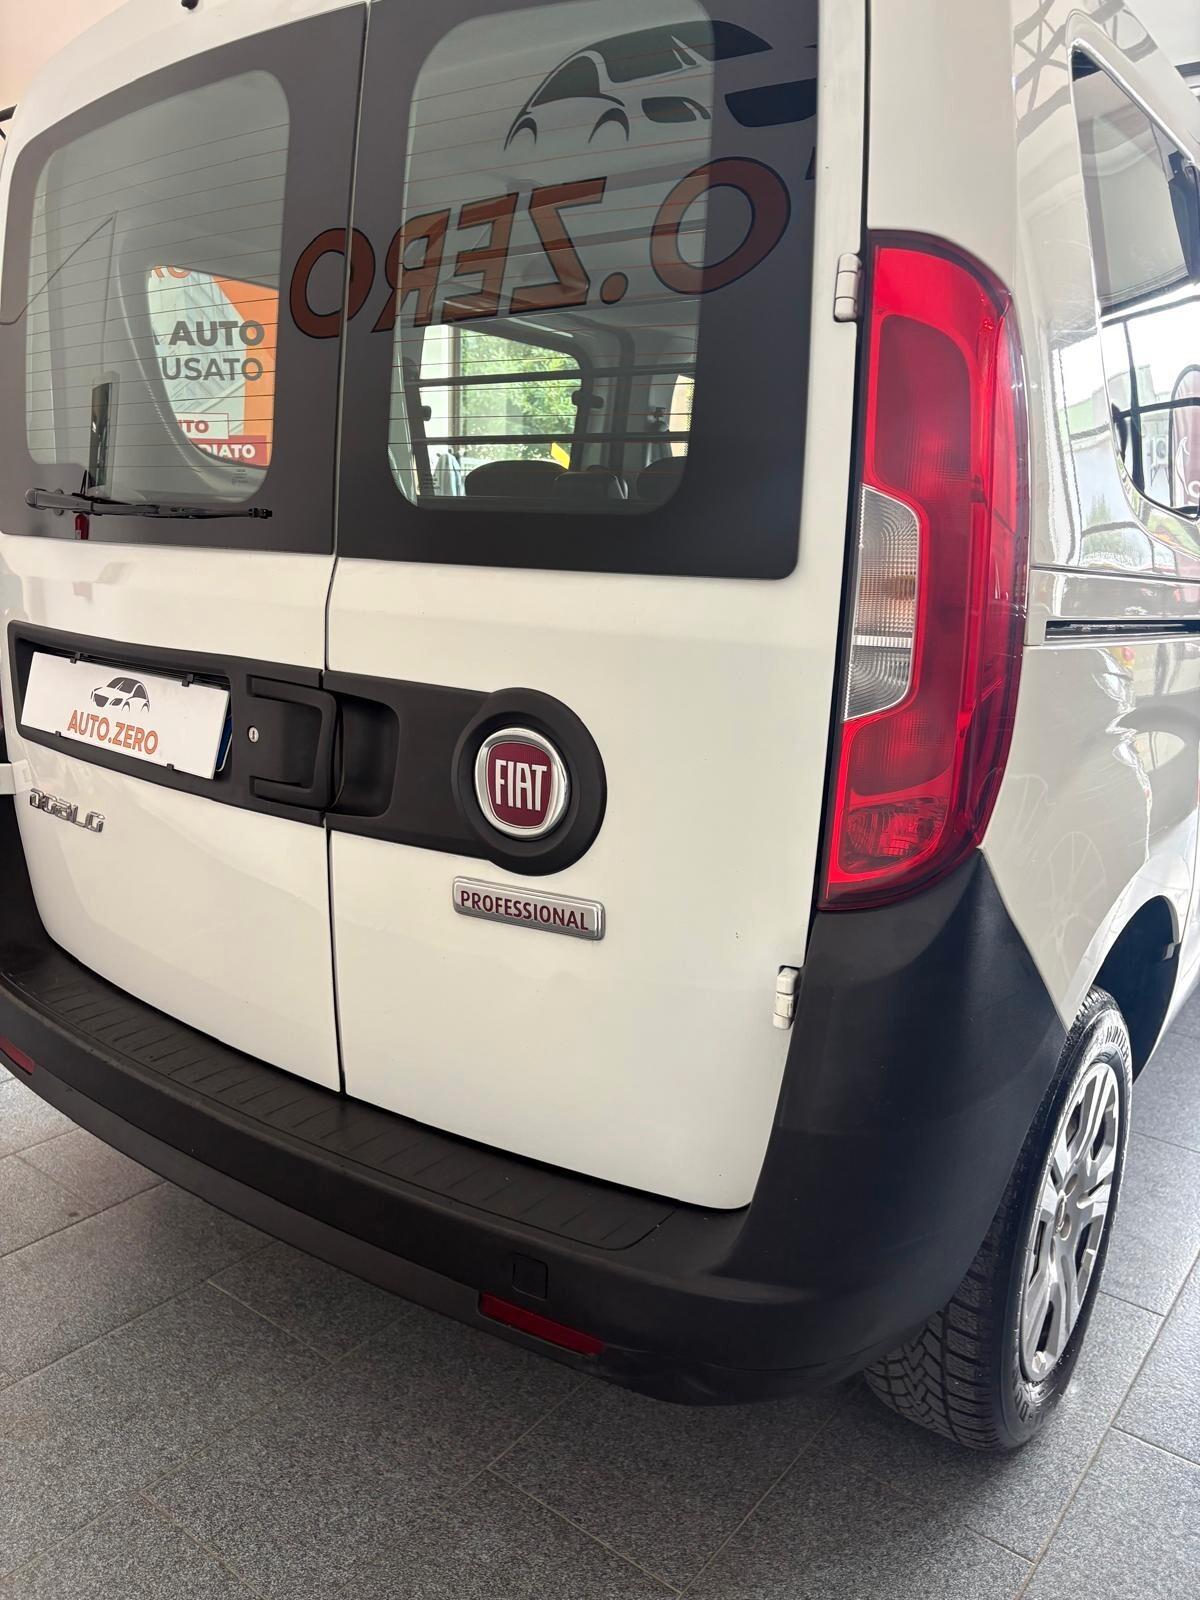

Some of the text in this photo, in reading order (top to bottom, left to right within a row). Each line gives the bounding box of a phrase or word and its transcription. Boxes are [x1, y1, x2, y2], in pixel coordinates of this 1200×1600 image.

[168, 320, 265, 347] AUTO
[161, 357, 263, 381] USATO
[67, 709, 159, 755] AUTO.ZERO
[495, 758, 548, 811] FIAT
[460, 890, 589, 931] PROFESSIONAL
